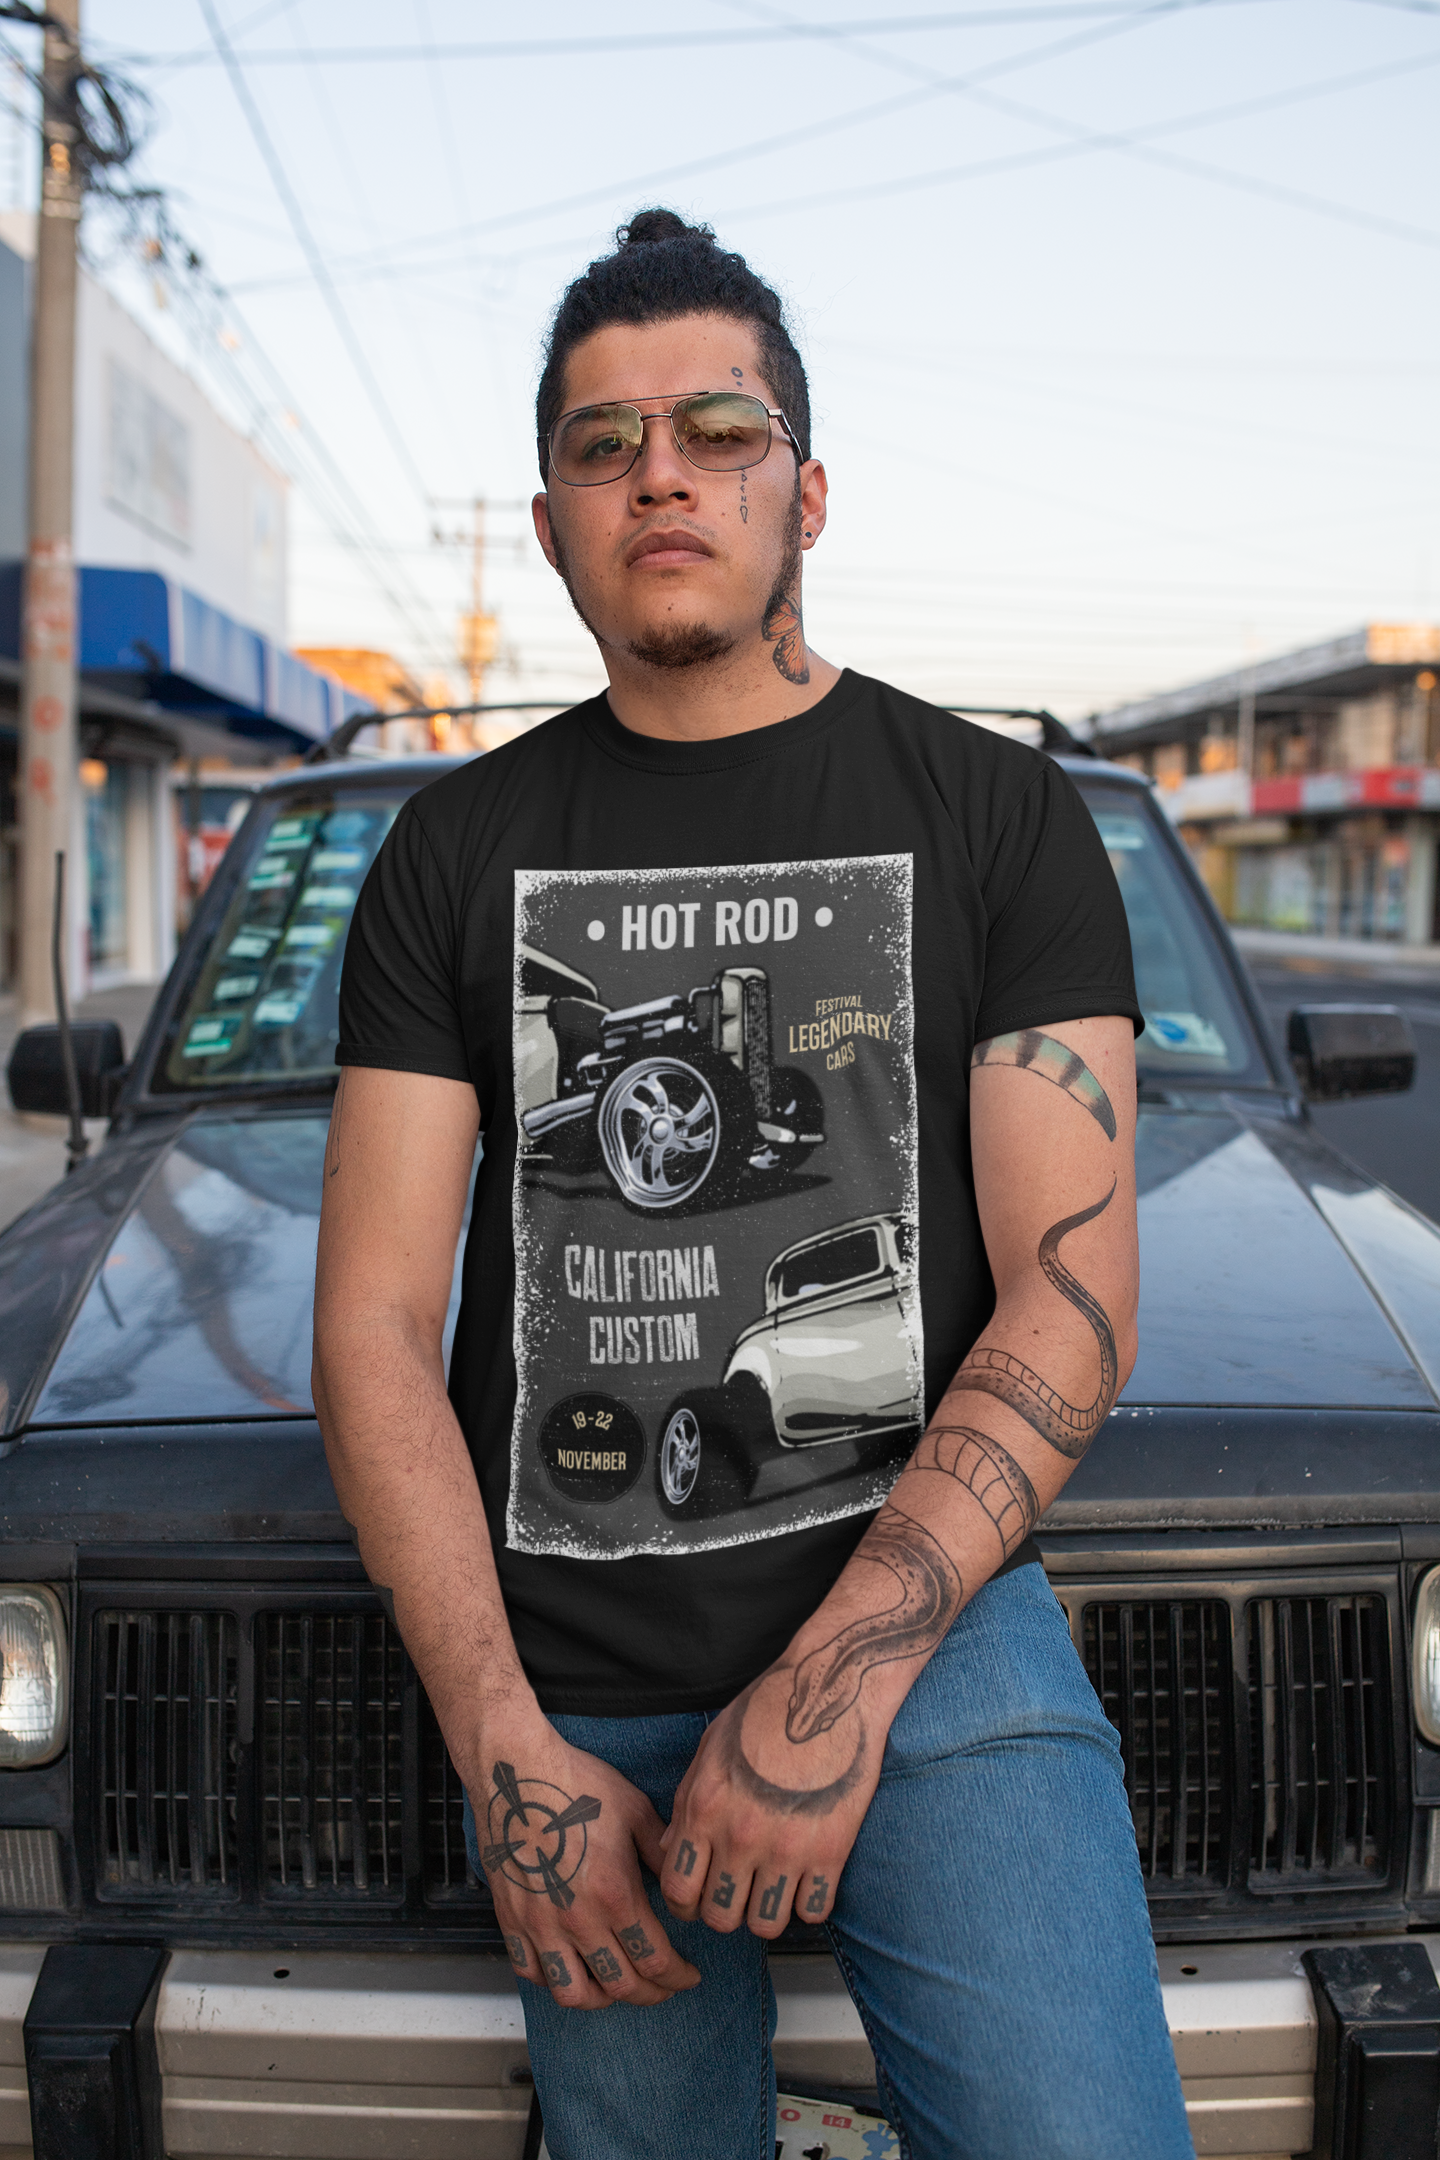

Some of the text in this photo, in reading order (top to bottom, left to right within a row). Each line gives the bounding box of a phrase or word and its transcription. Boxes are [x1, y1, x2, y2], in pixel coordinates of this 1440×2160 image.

[622, 897, 799, 951] HOT ROD
[815, 995, 863, 1017] FESTIVAL
[789, 1011, 893, 1053] LEGENDARY
[826, 1041, 856, 1071] CARS
[564, 1244, 720, 1303] CALIFORNIA
[589, 1312, 700, 1364] CUSTOM
[557, 1448, 627, 1471] NOVEMBER
[826, 2115, 848, 2128] 14
